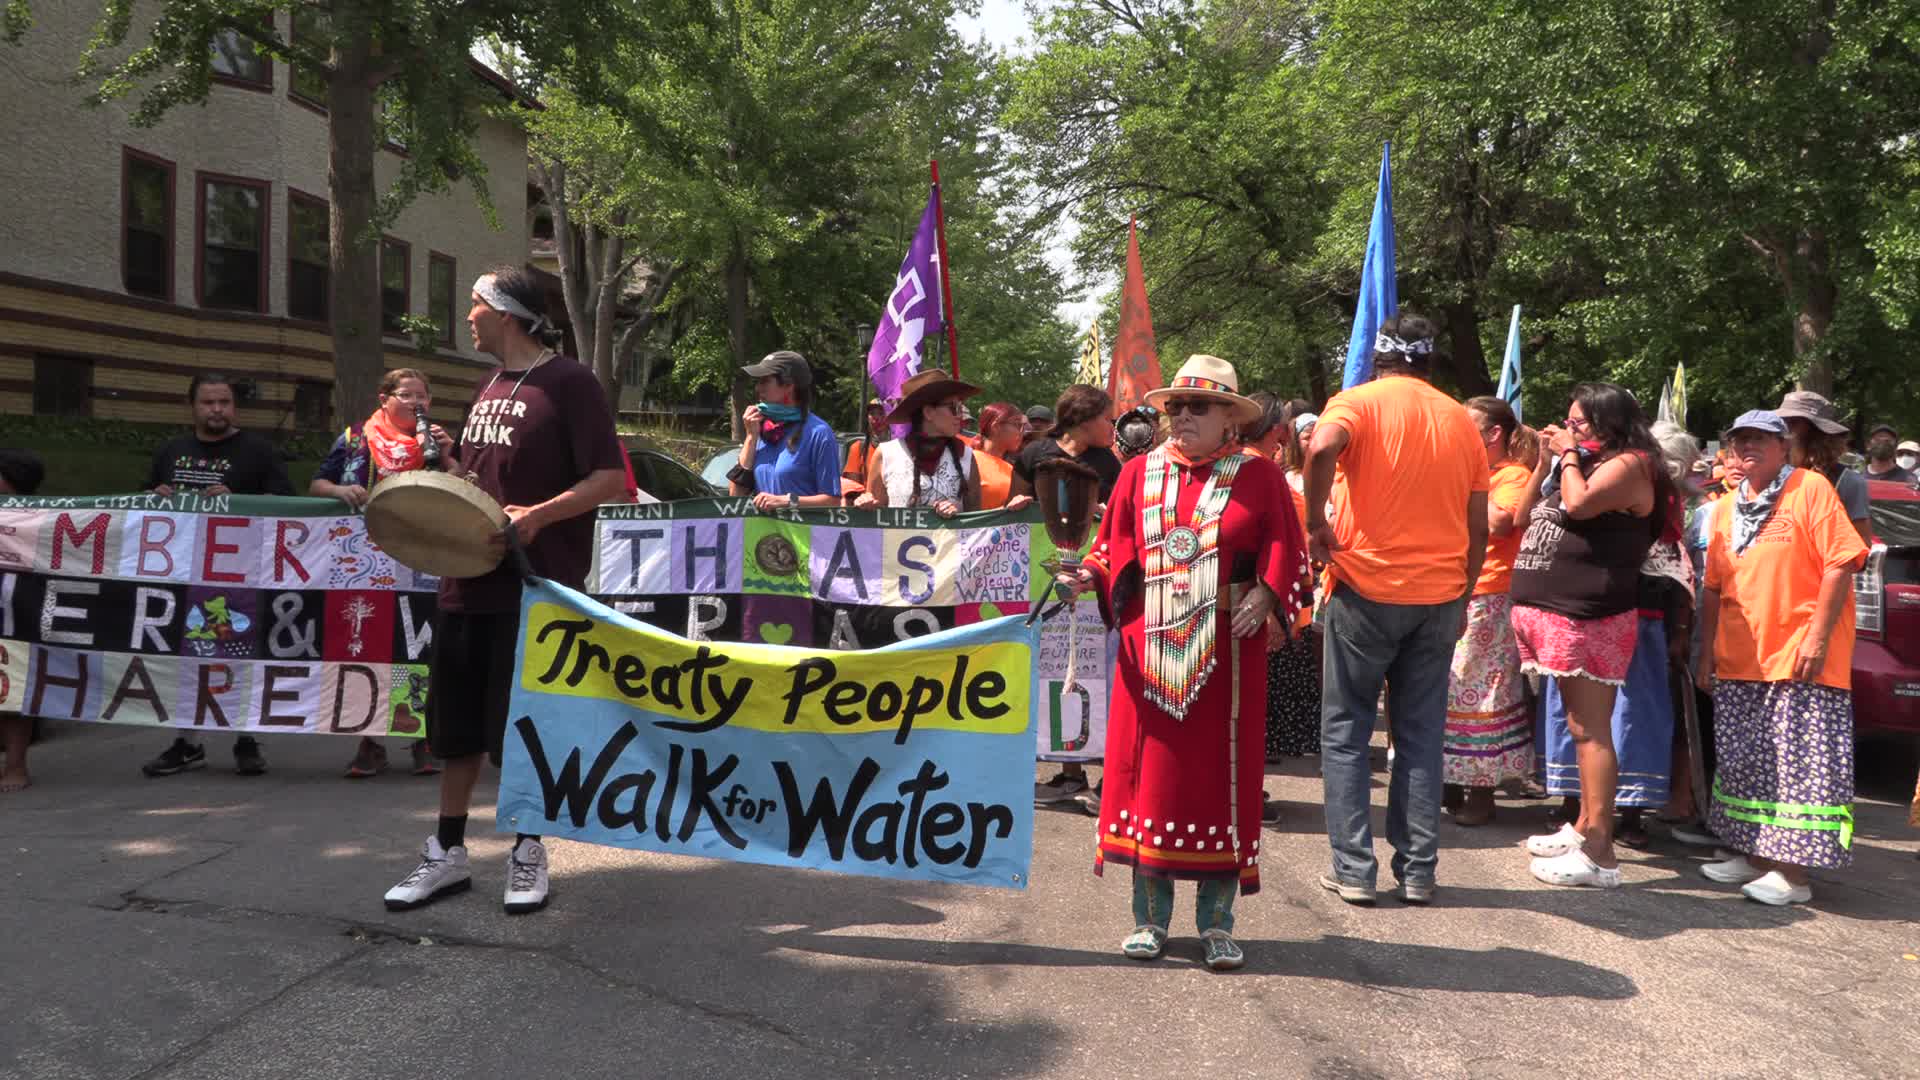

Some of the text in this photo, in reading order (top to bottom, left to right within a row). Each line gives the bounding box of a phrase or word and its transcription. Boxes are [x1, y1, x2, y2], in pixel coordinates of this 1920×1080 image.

[471, 399, 527, 418] STER
[713, 497, 804, 522] WAER
[828, 508, 850, 525] IS
[876, 508, 929, 528] LIFE
[960, 539, 1020, 563] Everyone
[960, 553, 1009, 581] Needs
[954, 583, 1025, 603] WATER
[268, 590, 320, 658] &
[1039, 646, 1097, 661] FUTRE
[536, 618, 1011, 745] Treaty People
[514, 715, 1013, 869] Walk for Water
